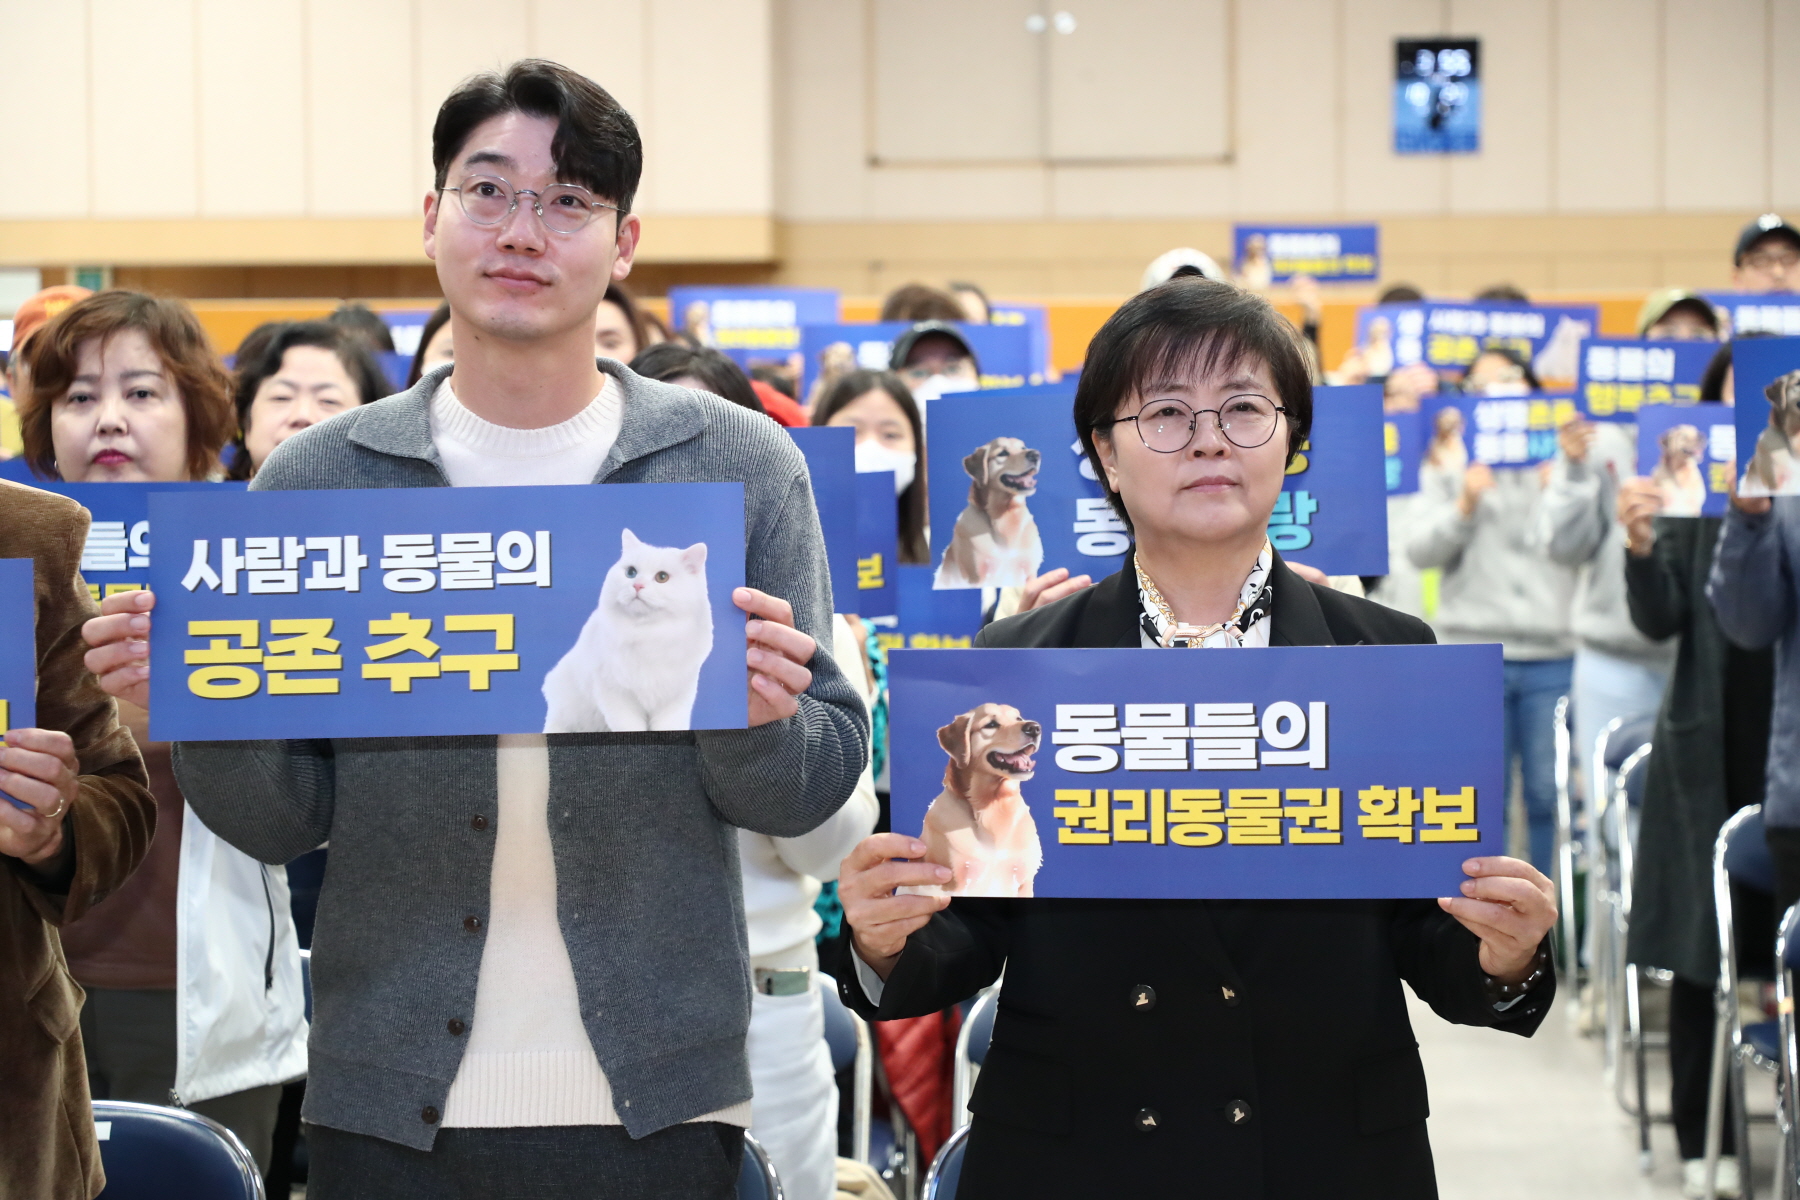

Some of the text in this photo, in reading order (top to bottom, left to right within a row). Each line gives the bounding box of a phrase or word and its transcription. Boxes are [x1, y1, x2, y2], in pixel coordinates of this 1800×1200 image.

[181, 530, 551, 594] 사람과 동물의
[184, 612, 519, 699] 공존 추구
[1051, 700, 1326, 773] 동물들의
[1053, 784, 1478, 846] 권리동물권 확보
